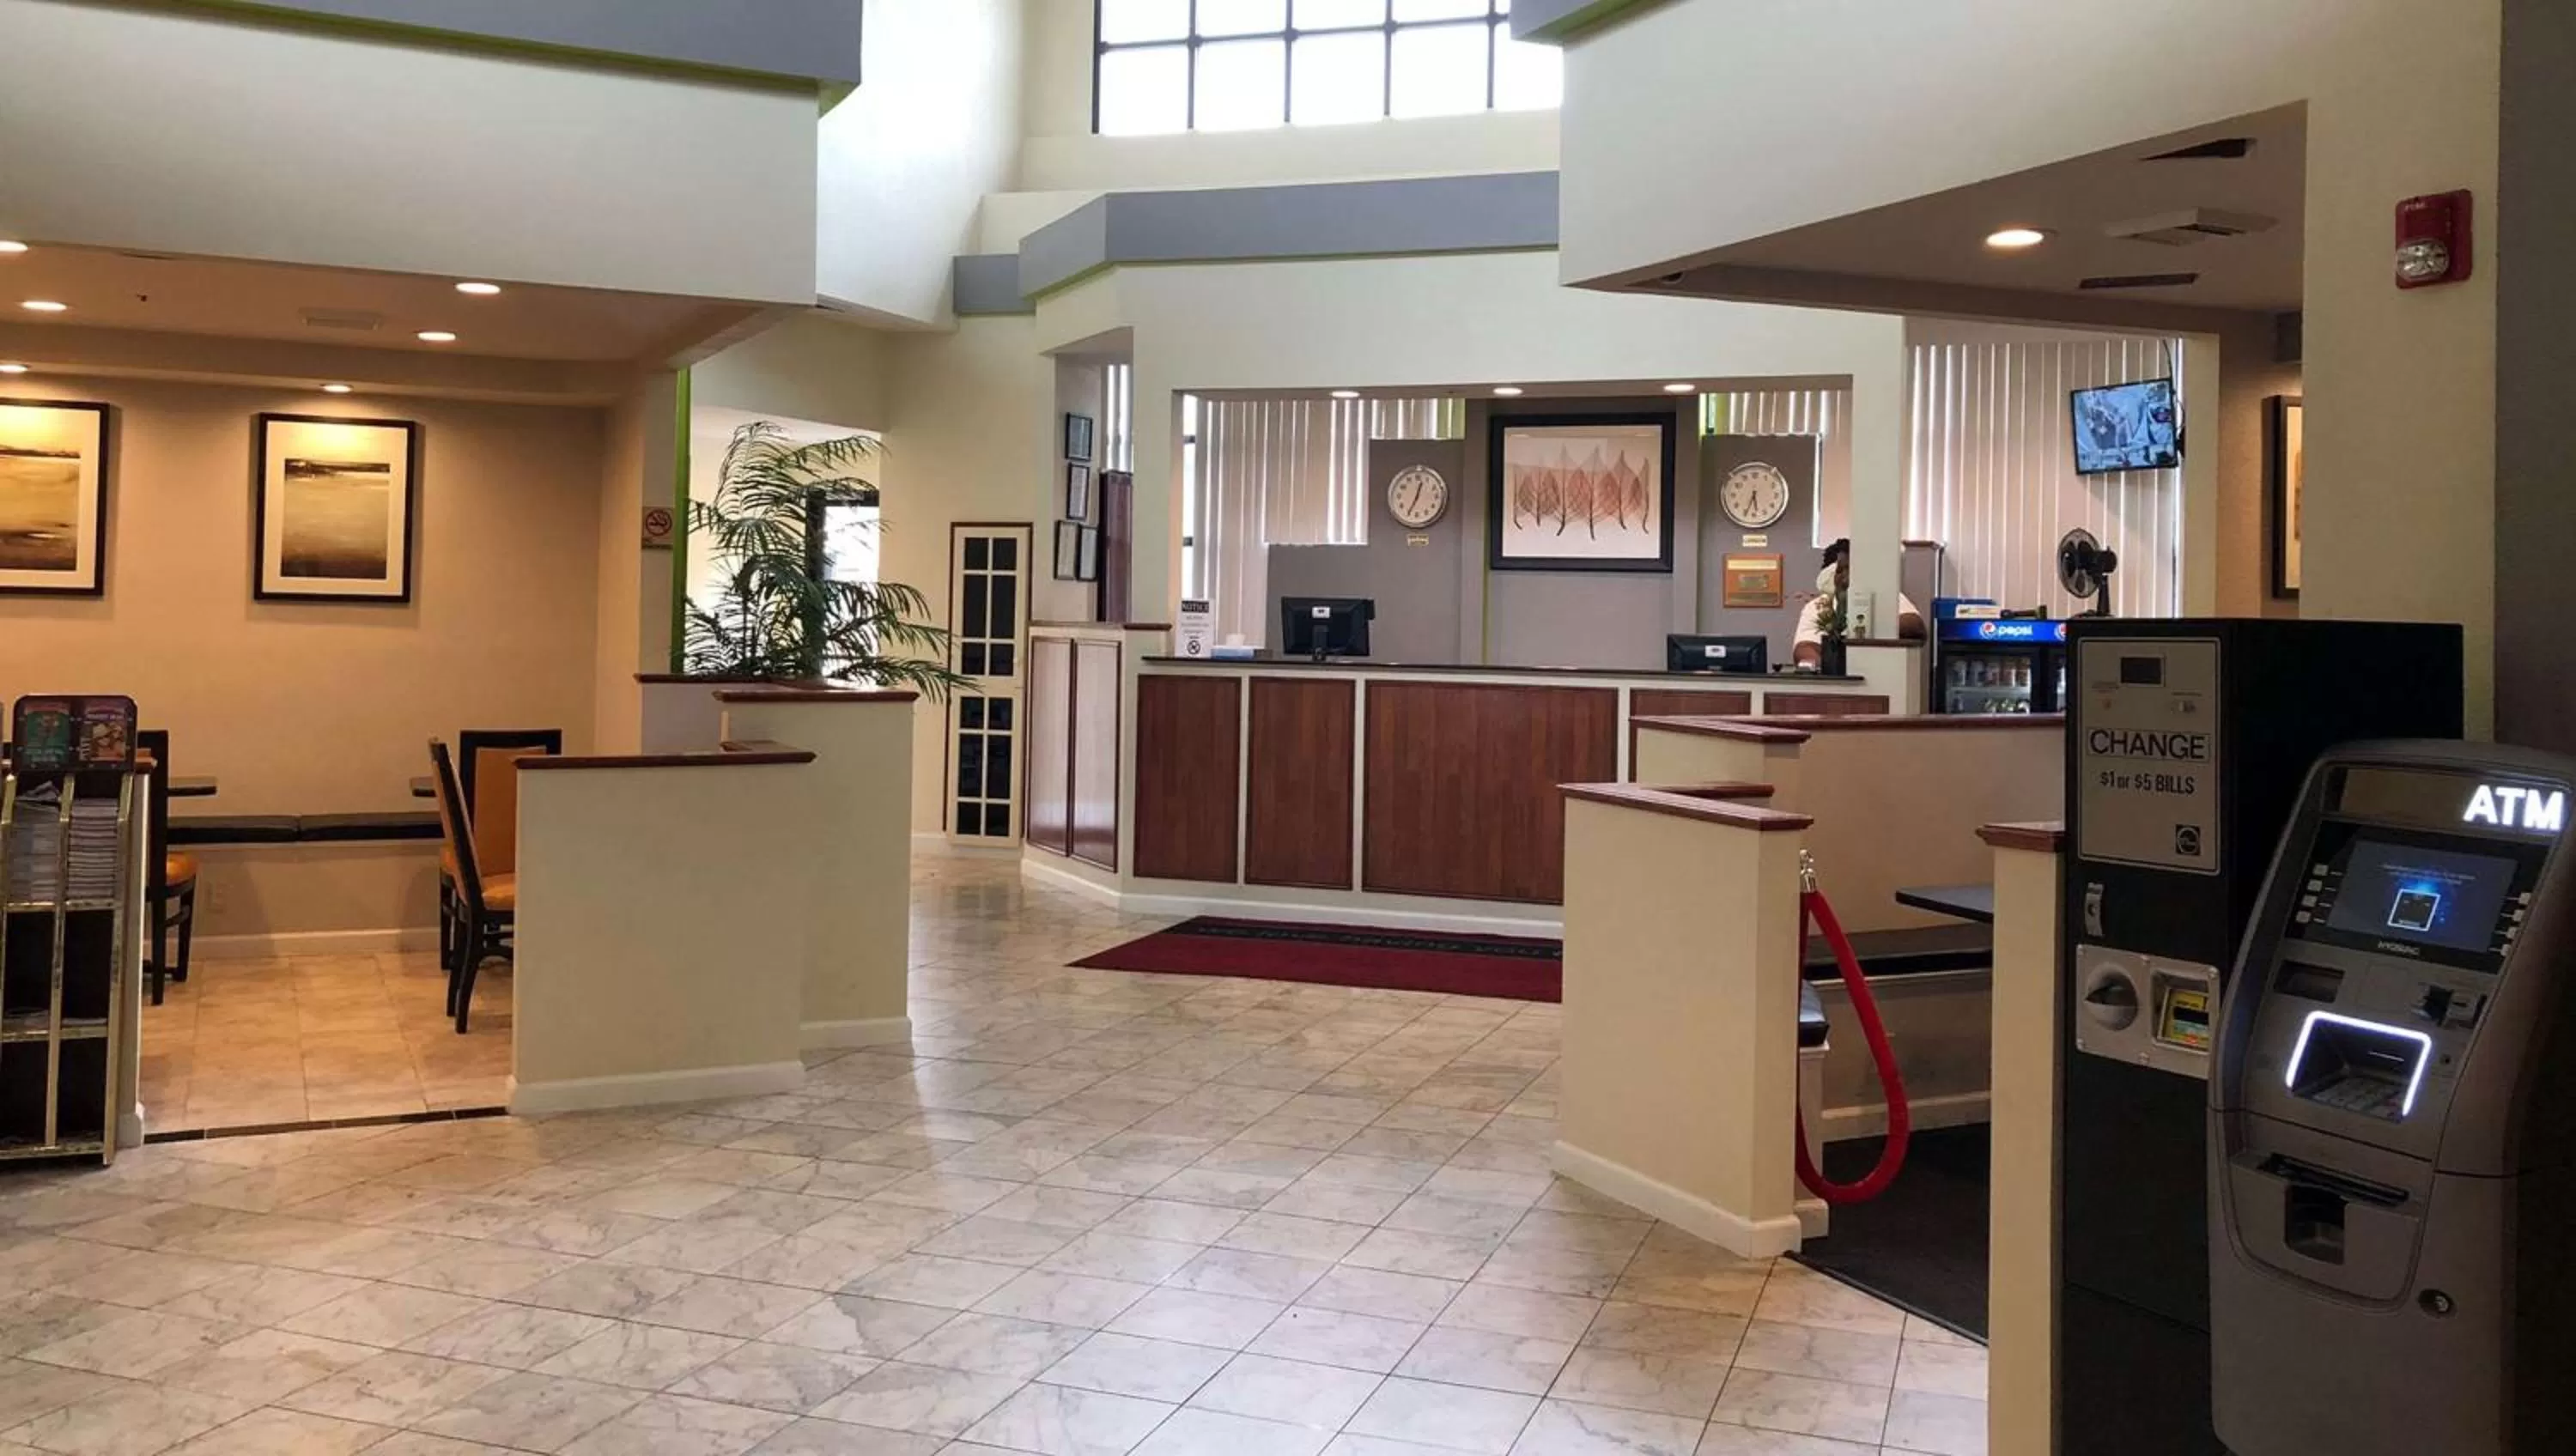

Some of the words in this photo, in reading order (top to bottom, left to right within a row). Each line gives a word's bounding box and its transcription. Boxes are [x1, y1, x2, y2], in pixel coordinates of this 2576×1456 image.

[1997, 625, 2033, 637] pepsi
[2090, 730, 2205, 760] CHANGE
[2099, 771, 2114, 787] $1
[2117, 776, 2129, 789] or
[2135, 773, 2151, 791] $5
[2155, 774, 2195, 795] BILLS
[2463, 784, 2564, 830] ATM
